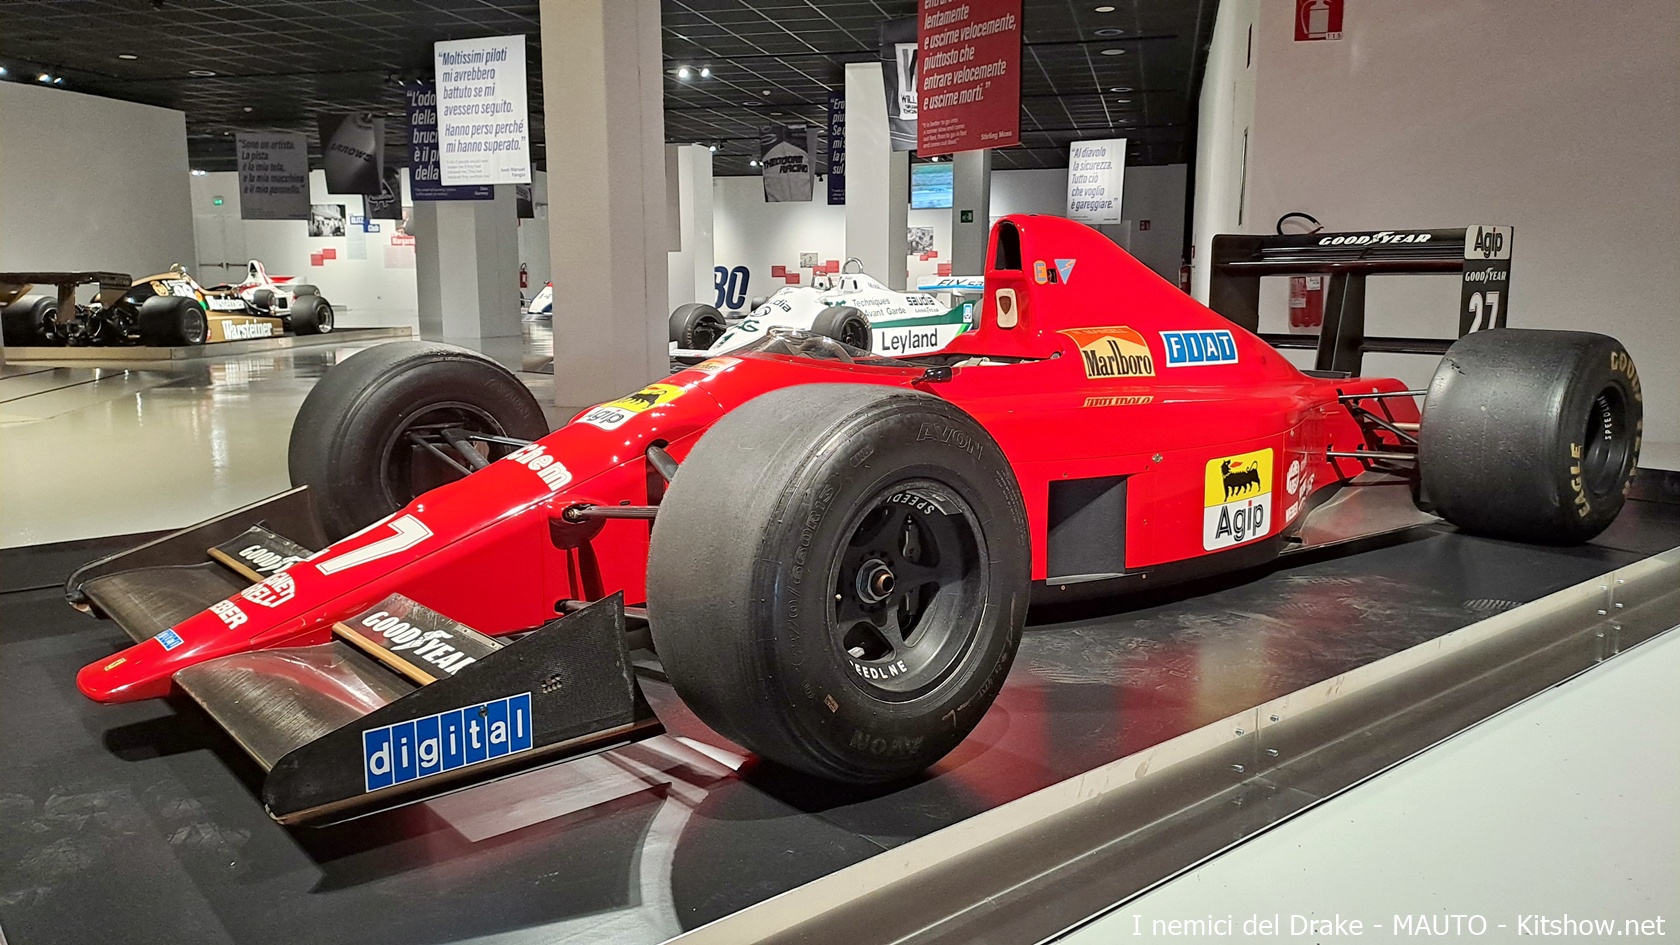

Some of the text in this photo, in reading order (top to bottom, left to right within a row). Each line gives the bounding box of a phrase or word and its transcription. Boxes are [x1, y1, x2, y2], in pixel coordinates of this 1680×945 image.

[924, 4, 970, 30] lentamente
[924, 13, 1016, 50] e uscirne velocemente,
[438, 47, 508, 66] “Moltissimi piloti
[923, 44, 975, 75] piuttosto che
[442, 67, 495, 83] mi avrebbero
[924, 58, 1007, 90] entrare velocemente
[443, 82, 496, 99] battuto se mi
[444, 100, 514, 116] avessero seguito.
[924, 97, 929, 110] e
[929, 90, 958, 109] uscirne
[412, 109, 436, 125] della
[445, 119, 524, 138] Hanno perso perché
[832, 125, 841, 136] Se
[260, 141, 270, 149] un
[446, 138, 456, 153] mi
[457, 137, 482, 152] hanno
[1082, 146, 1106, 158] diavolo
[241, 151, 269, 162] La pista
[421, 148, 429, 161] il
[415, 165, 438, 180] della
[1073, 160, 1112, 171] la sicurezza.
[270, 174, 304, 184] macchina
[1071, 174, 1087, 184] Tutto
[1071, 185, 1105, 198] che voglio
[1473, 226, 1503, 258] Agip
[887, 307, 906, 316] Garde
[1468, 291, 1499, 334] 27
[221, 319, 273, 340] Warsteiner
[882, 328, 938, 354] Leyland
[1168, 335, 1232, 358] FIAT
[1082, 340, 1153, 376] Marlboro
[1215, 500, 1264, 541] Agip
[369, 708, 523, 776] digital
